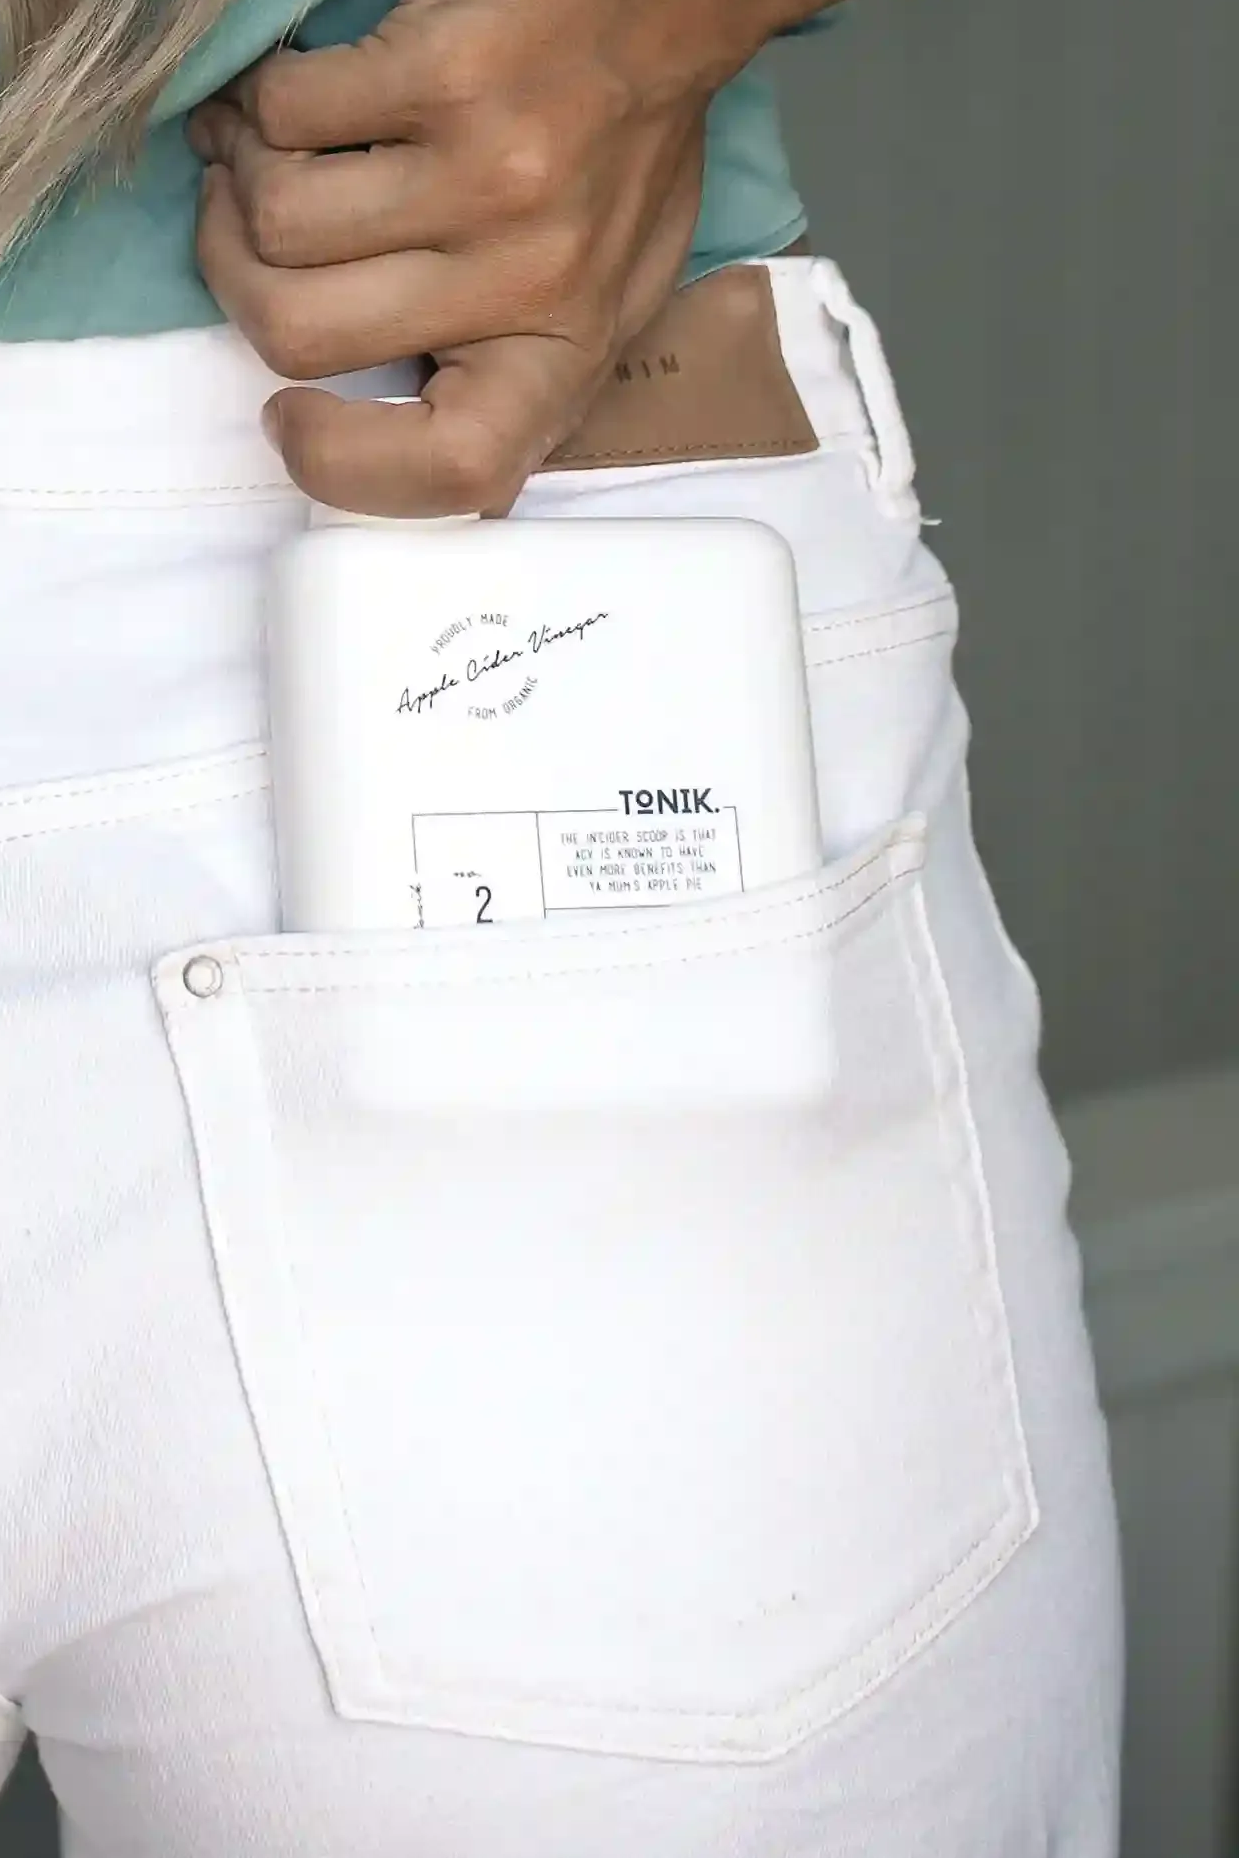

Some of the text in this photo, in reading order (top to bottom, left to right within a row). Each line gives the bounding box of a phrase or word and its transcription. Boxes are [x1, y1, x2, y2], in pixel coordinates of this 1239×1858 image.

[431, 613, 509, 656] PROUDLY MADE
[396, 613, 609, 714] Apple Cider Vinegar
[467, 675, 538, 721] FROM ORGANIC
[560, 832, 578, 846] THE
[637, 829, 668, 843] SCOOP
[675, 829, 686, 841] IS
[693, 828, 716, 841] THAT
[575, 844, 704, 861] ACV IS KNOWN TO HAVE
[566, 860, 717, 878] EVEN MORE BENEFITS THAN
[647, 877, 678, 891] APPLE
[686, 876, 702, 891] PIE
[475, 885, 493, 923] 2
